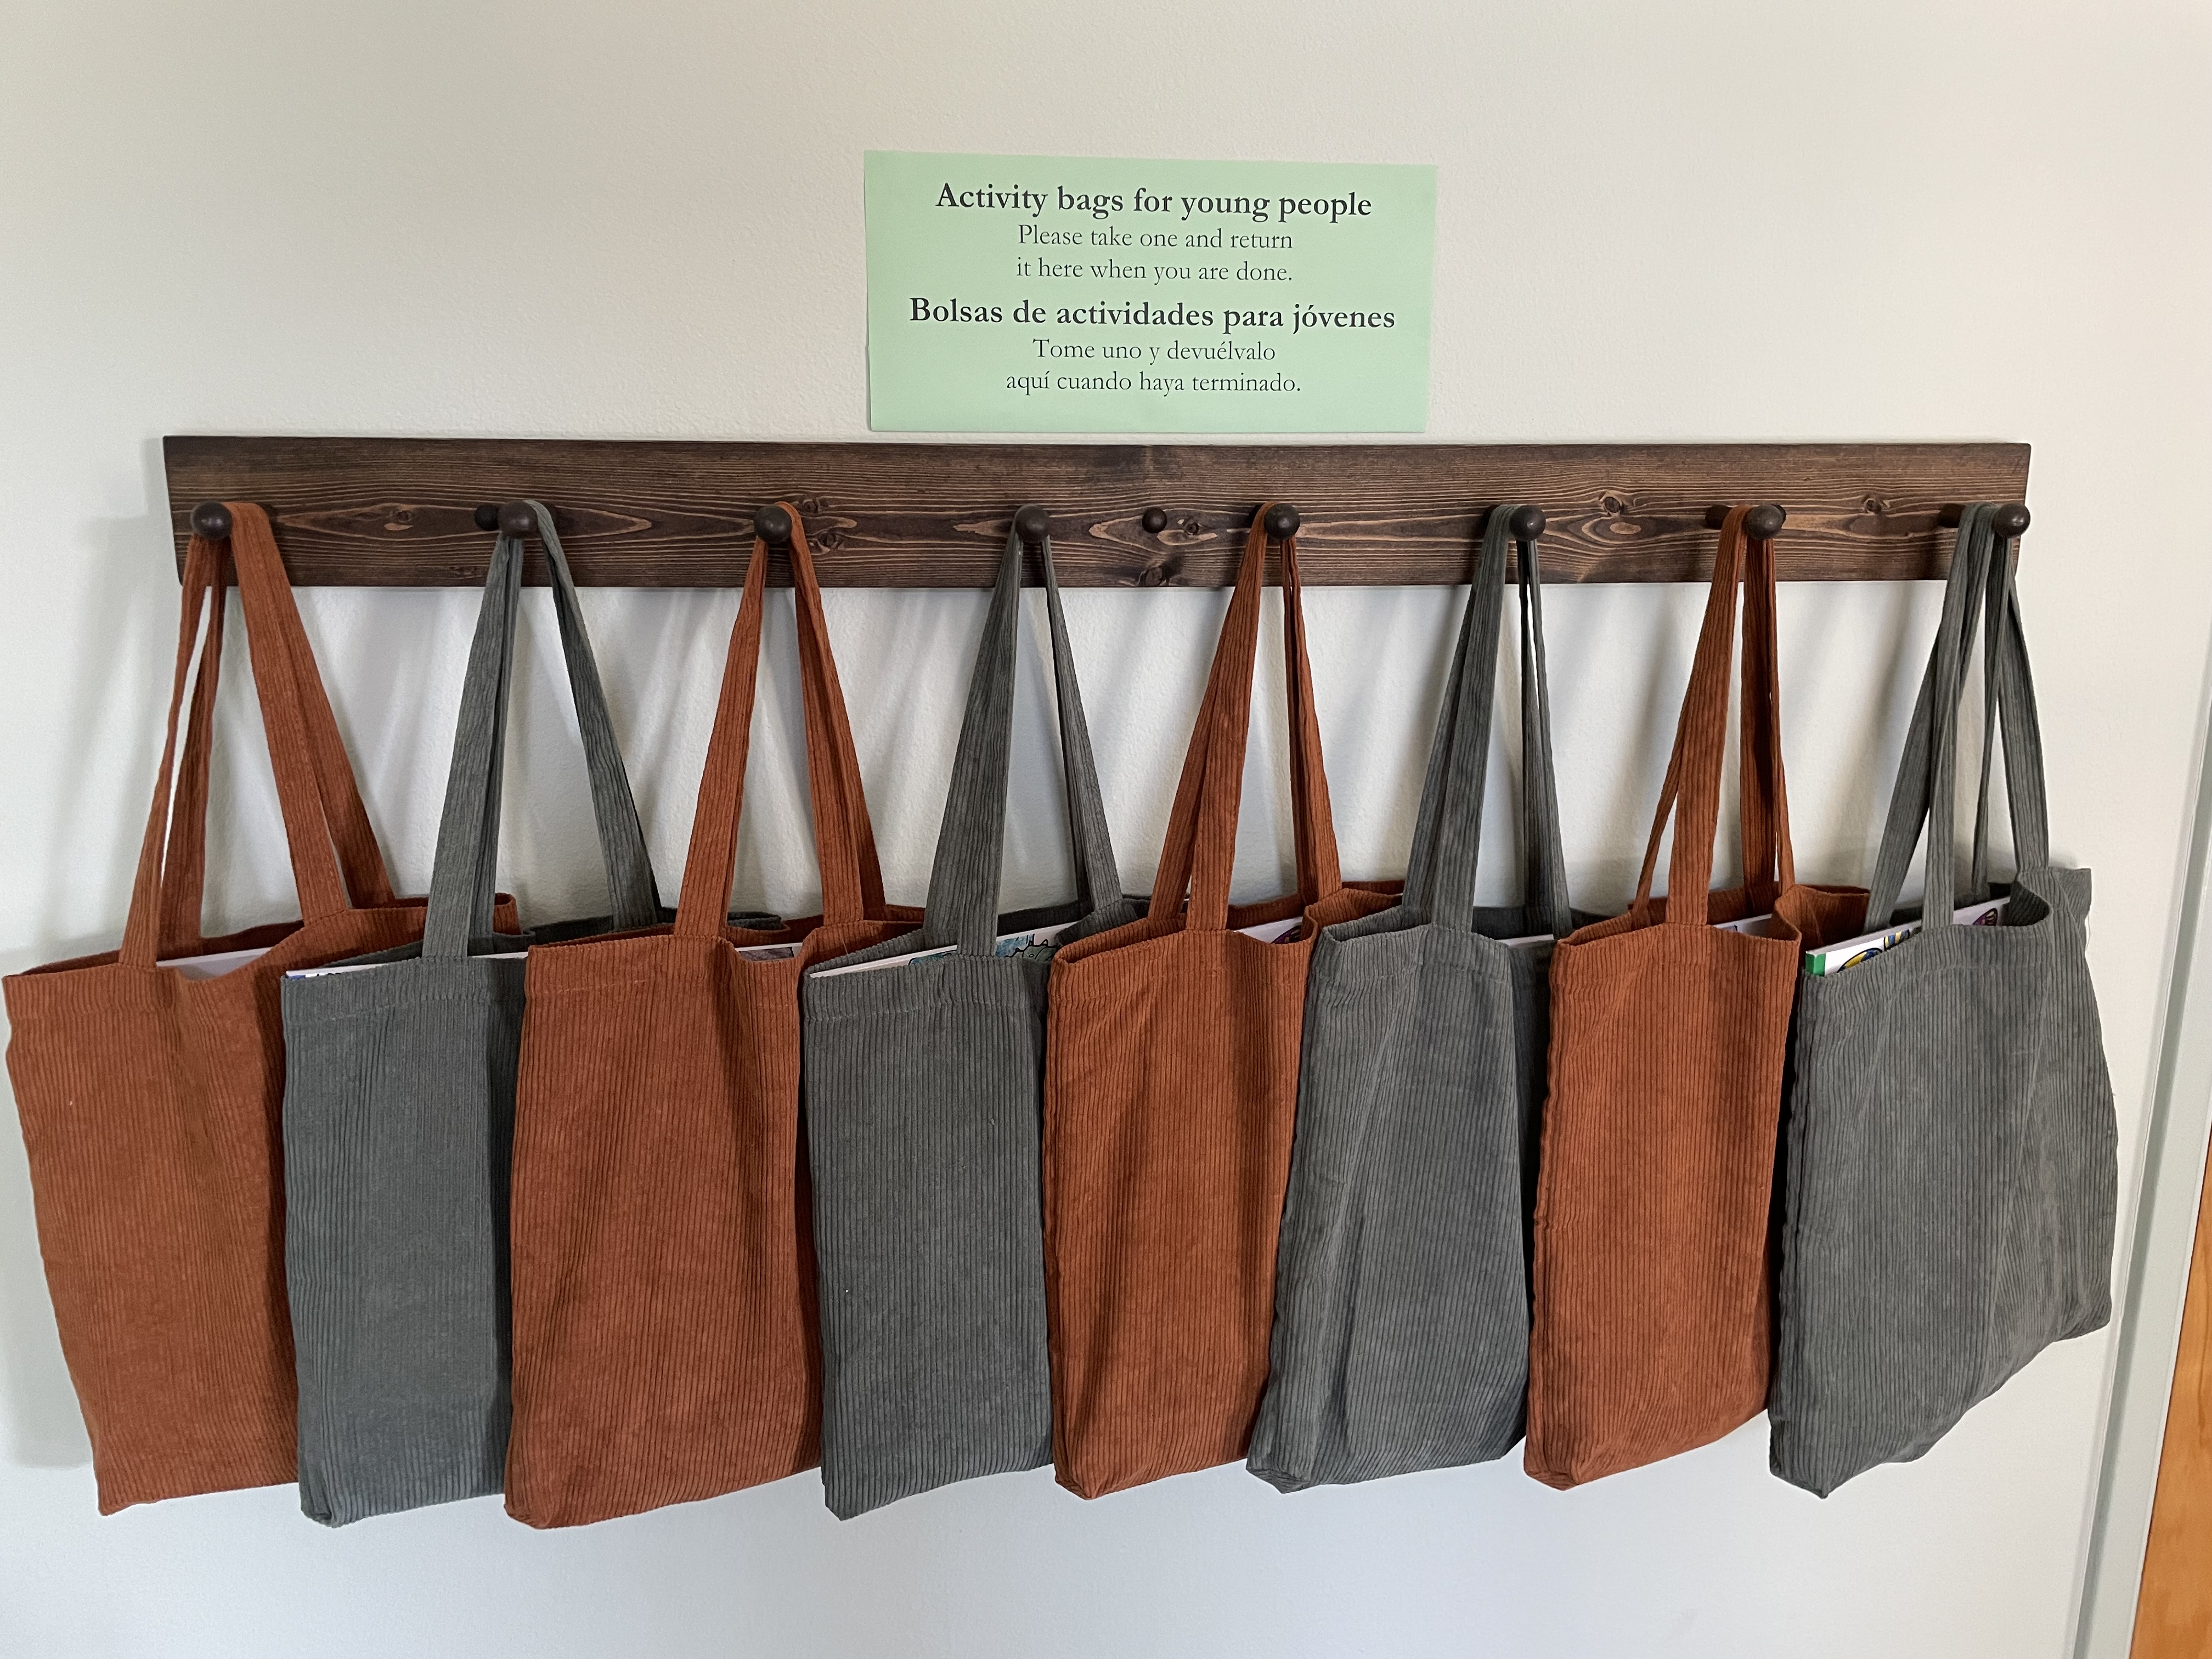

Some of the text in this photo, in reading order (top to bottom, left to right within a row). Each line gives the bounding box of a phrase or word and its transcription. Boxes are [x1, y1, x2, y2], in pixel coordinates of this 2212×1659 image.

[935, 182, 1372, 224] Activity bags for young people
[1017, 224, 1293, 249] Please take one and return
[1016, 256, 1292, 286] it here when you are done.
[909, 297, 1395, 335] Bolsas de actividades para jóvenes
[1032, 338, 1276, 366] Tome uno y devuélvalo
[1006, 370, 1300, 397] aquí cuando haya terminado.
